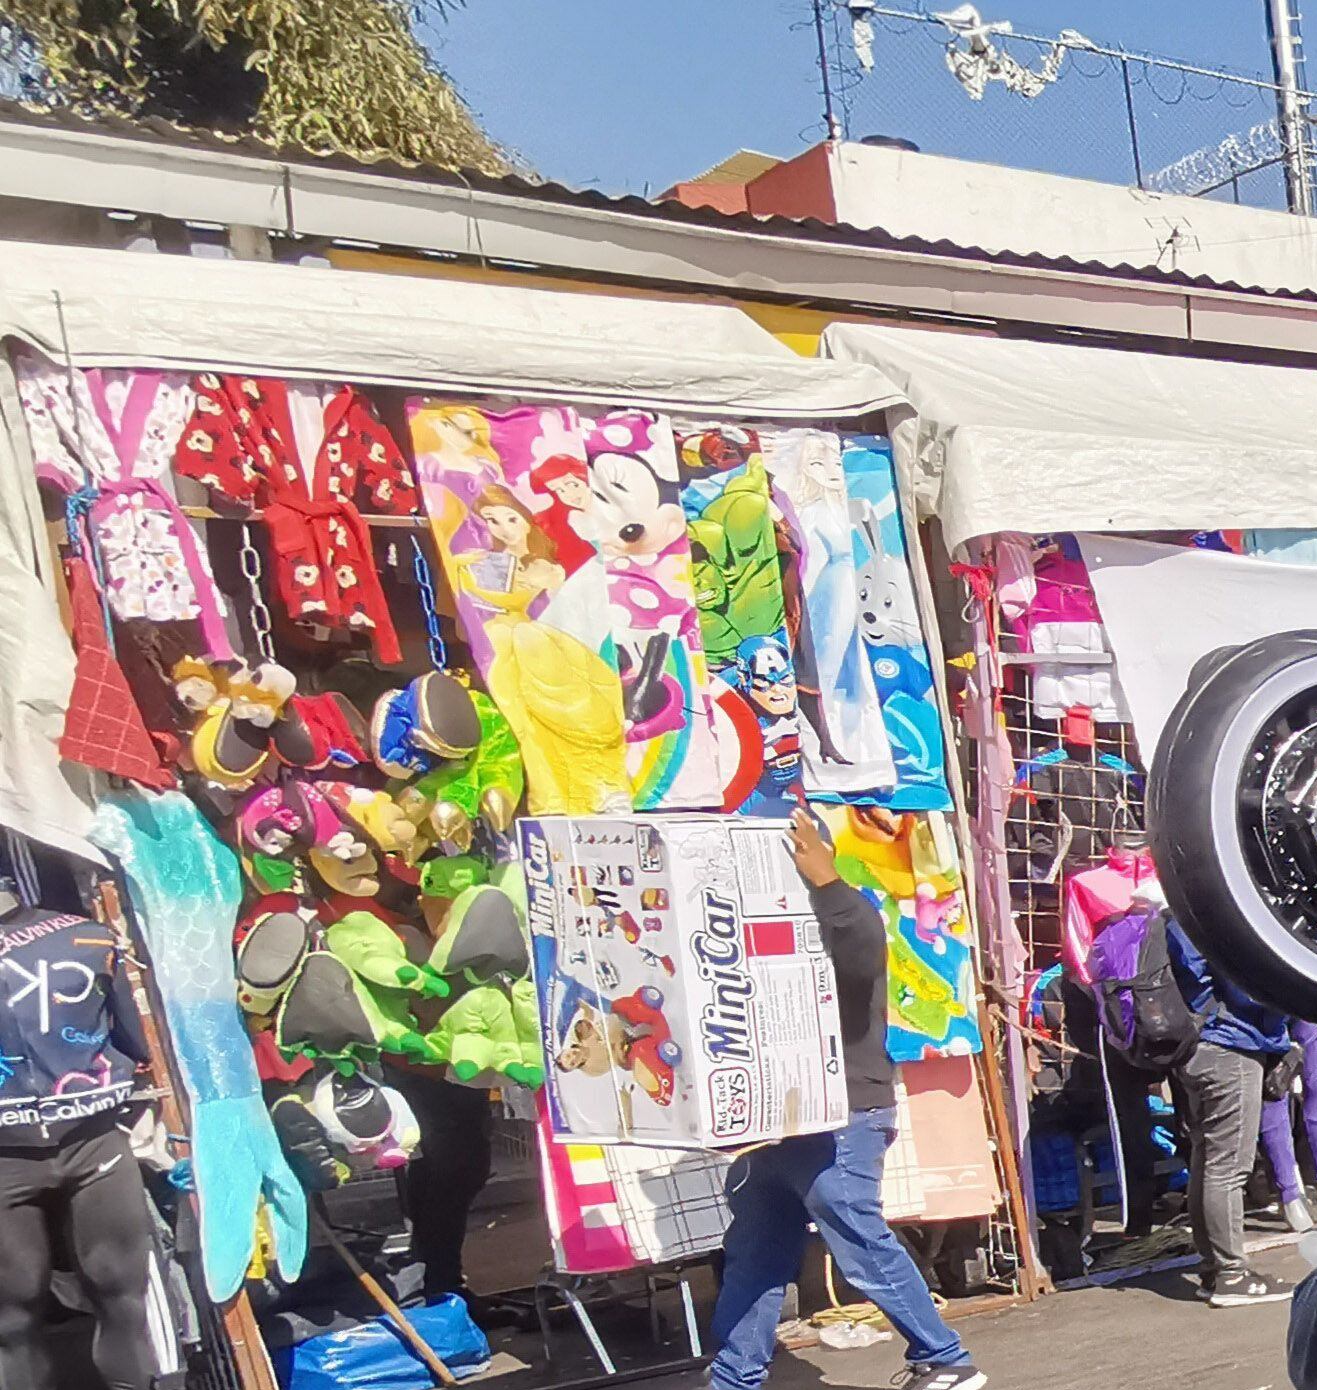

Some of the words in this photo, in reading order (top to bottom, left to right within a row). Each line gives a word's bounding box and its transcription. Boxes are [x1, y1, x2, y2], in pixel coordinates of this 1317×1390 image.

[525, 833, 556, 937] MiniCar
[694, 888, 755, 1063] MiniCar
[39, 1094, 116, 1121] Calvin
